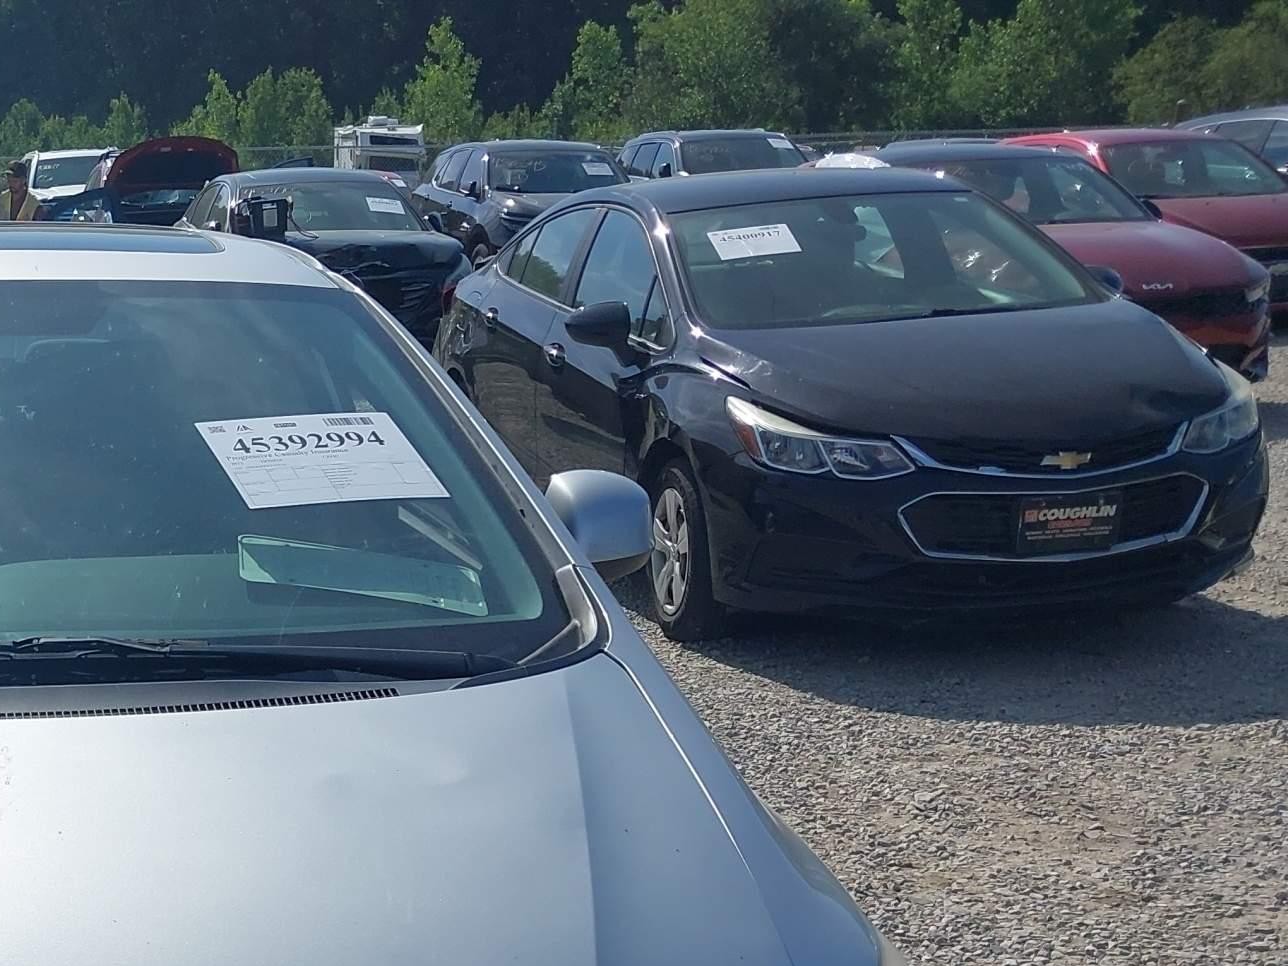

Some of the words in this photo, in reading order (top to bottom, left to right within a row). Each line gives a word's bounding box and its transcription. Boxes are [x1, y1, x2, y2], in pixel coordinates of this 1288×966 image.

[719, 230, 781, 243] 45400917
[232, 429, 386, 454] 45392994
[1038, 504, 1117, 521] COUGHLIN
